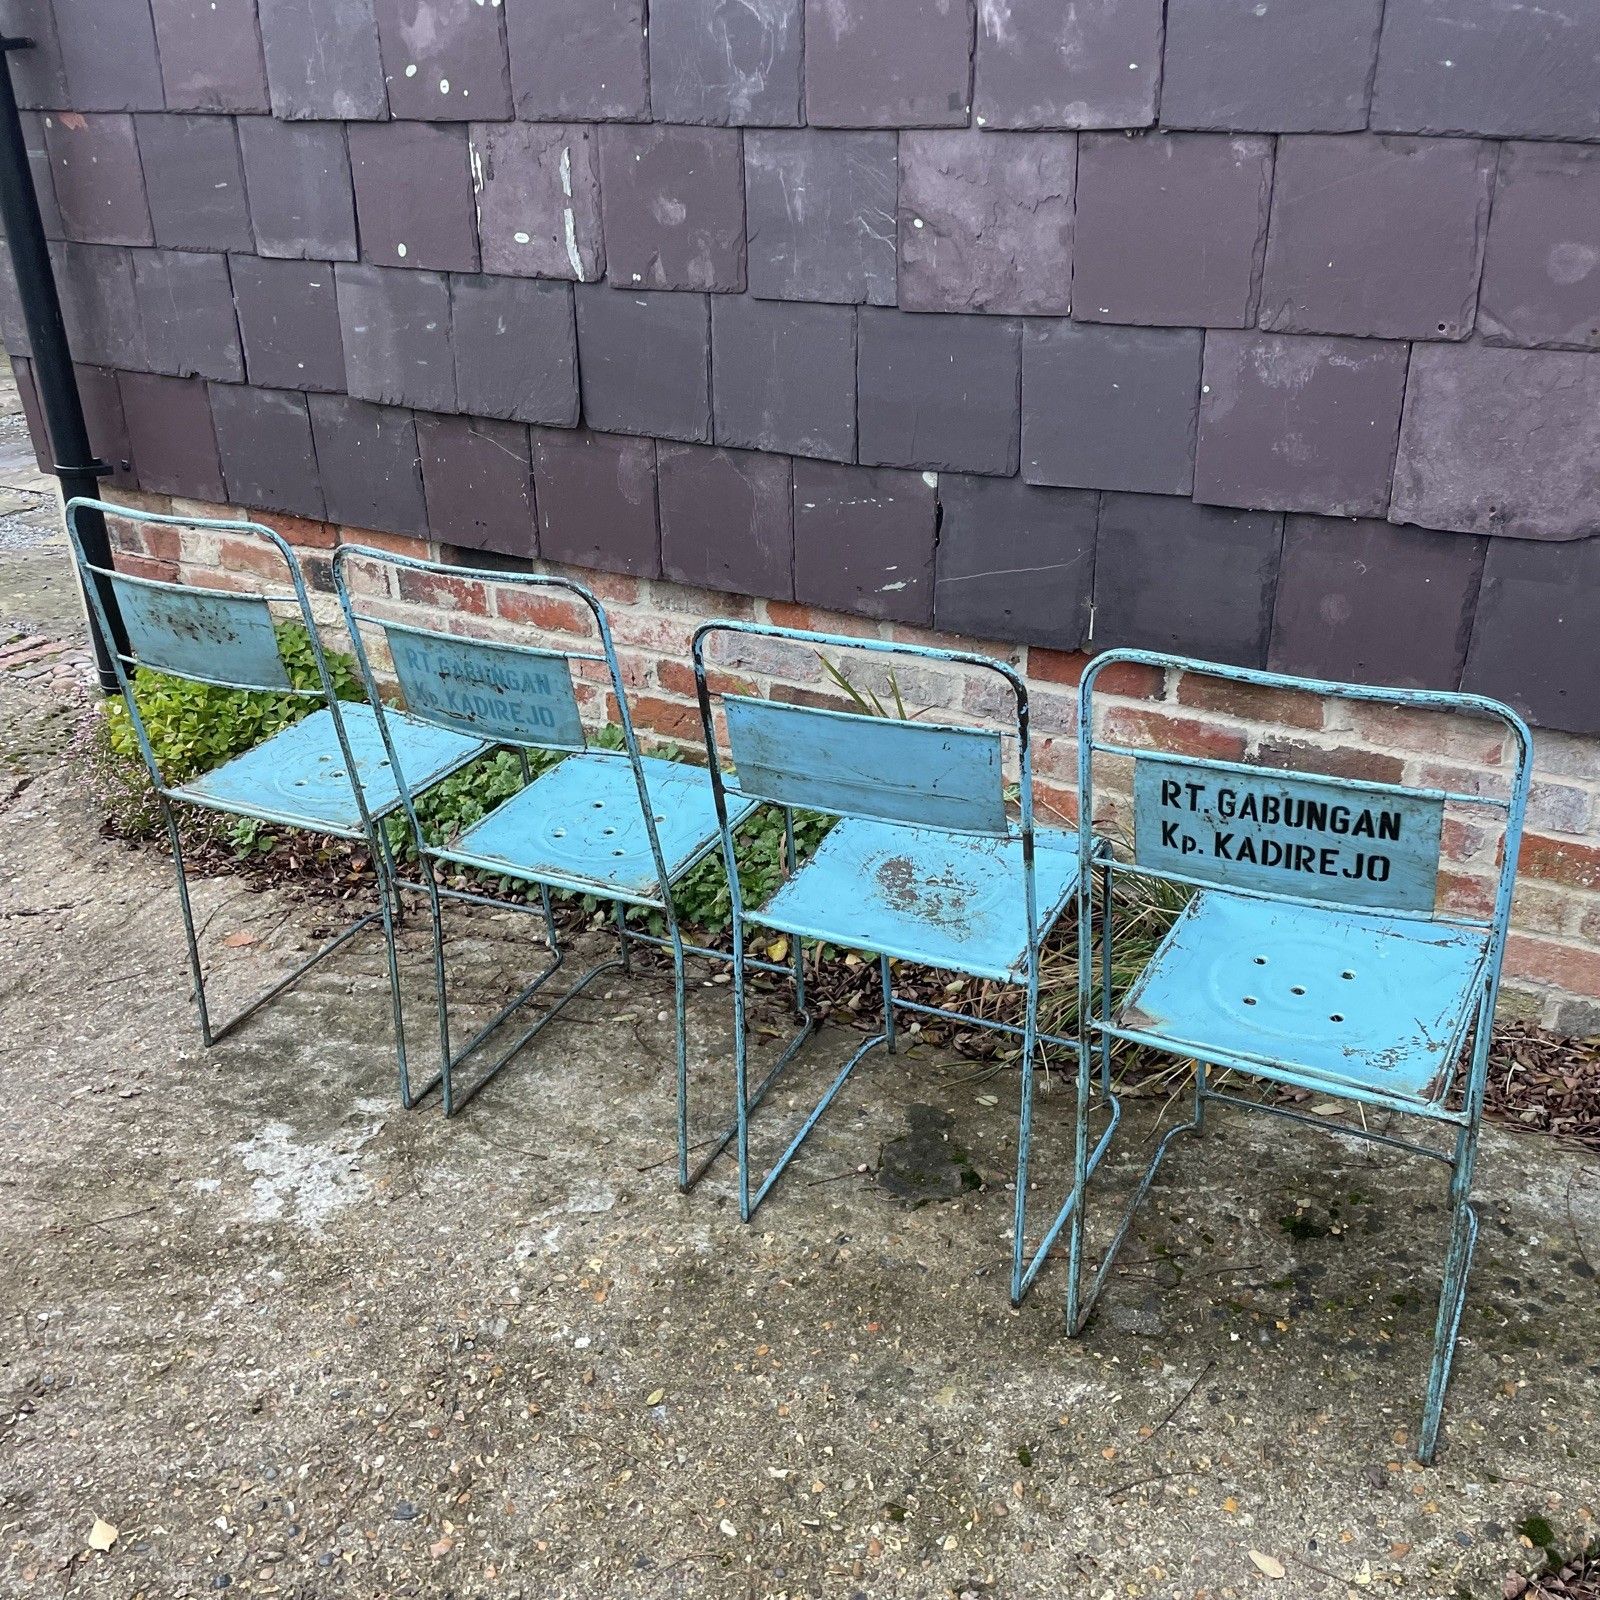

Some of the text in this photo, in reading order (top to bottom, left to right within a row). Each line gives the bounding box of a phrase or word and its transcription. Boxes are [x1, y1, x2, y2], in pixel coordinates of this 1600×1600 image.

[444, 689, 556, 728] KADIREJO
[1161, 820, 1391, 882] Kp. KADIREJO
